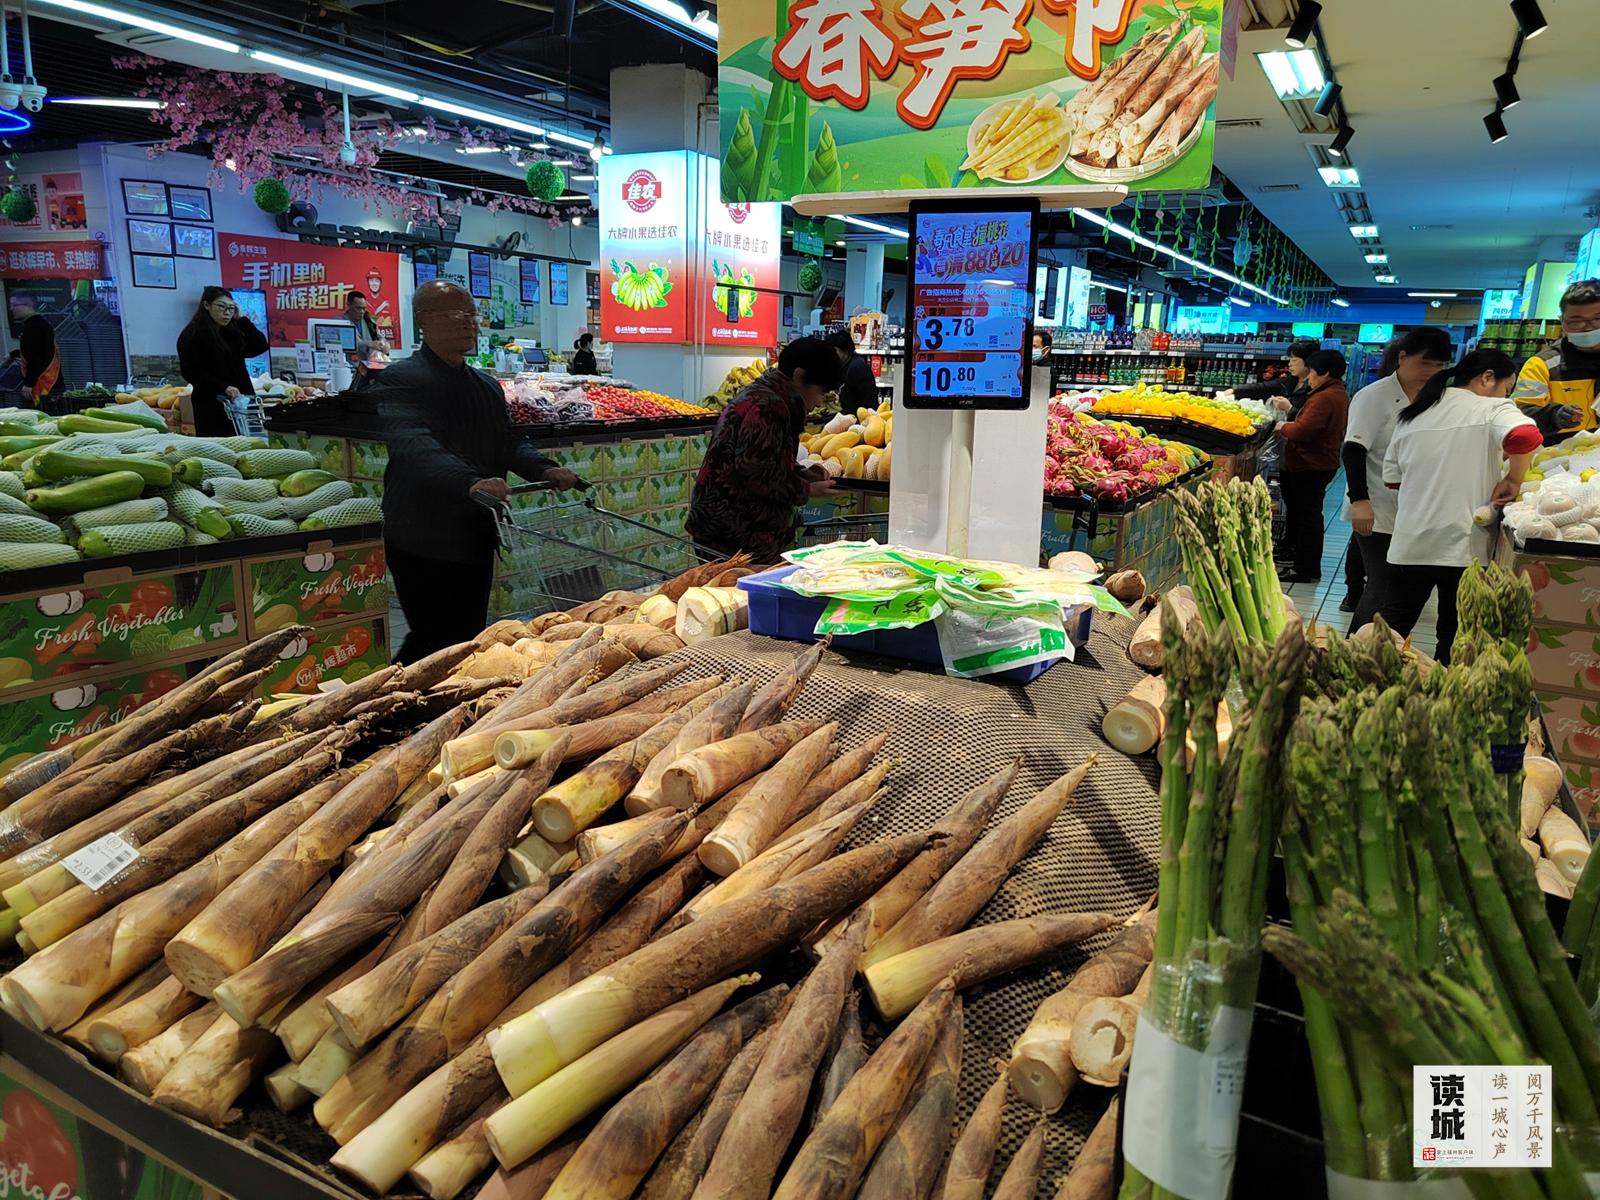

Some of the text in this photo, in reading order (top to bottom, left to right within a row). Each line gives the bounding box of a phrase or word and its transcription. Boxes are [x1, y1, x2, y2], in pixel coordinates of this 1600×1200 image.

[628, 182, 656, 199] 佳农
[608, 226, 678, 239] 大牌水果选佳农
[242, 262, 325, 290] 手机里的
[276, 282, 354, 311] 永辉超市
[924, 318, 975, 350] 3.78
[921, 367, 975, 391] 10.80
[300, 577, 341, 600] Fresh
[34, 606, 184, 651] Fresh Vegetables
[314, 643, 357, 680] 永辉超市
[49, 711, 109, 745] Fresh
